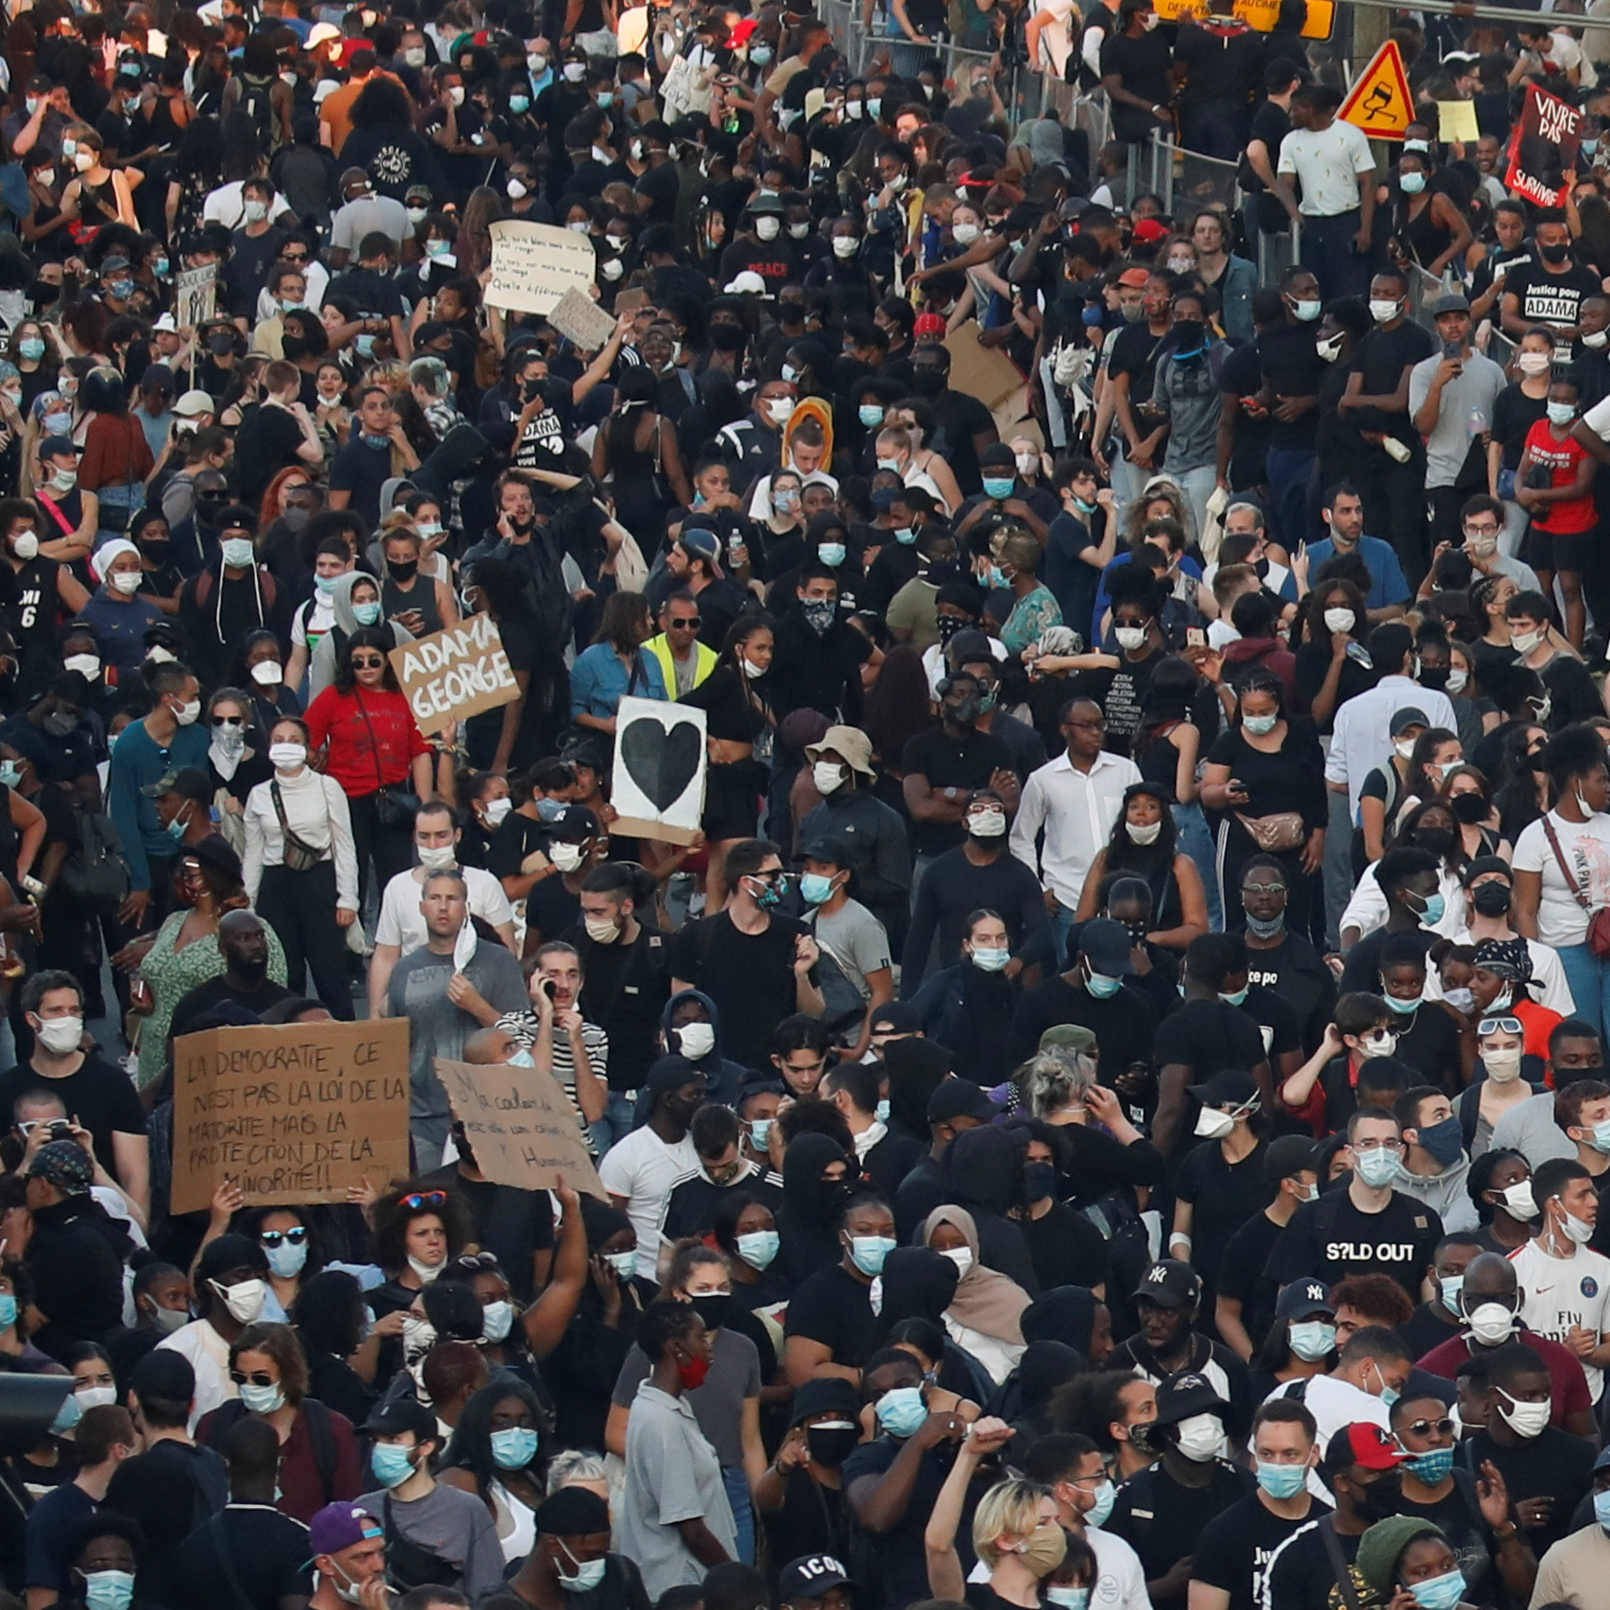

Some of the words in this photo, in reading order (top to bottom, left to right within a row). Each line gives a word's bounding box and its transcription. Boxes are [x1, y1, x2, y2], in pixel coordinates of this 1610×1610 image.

[1535, 90, 1580, 135] VIVRE
[1539, 120, 1562, 145] PAS
[1512, 169, 1565, 207] SURVIVRE
[1526, 283, 1557, 296] Justice
[1558, 286, 1580, 300] pour
[1525, 299, 1578, 319] ADAMA
[526, 413, 562, 438] DAMA
[21, 605, 38, 629] 6
[404, 615, 500, 683] ADAMA
[411, 652, 517, 719] GEORGE
[187, 1057, 207, 1084] LA
[352, 1041, 382, 1067] CE
[243, 1081, 282, 1109] PAS
[289, 1080, 312, 1107] LA
[349, 1079, 378, 1104] DE
[384, 1078, 406, 1101] LA
[327, 1111, 347, 1135] LA
[188, 1138, 304, 1174] PROTECTION
[314, 1140, 344, 1163] DE
[351, 1136, 374, 1162] LA
[1327, 1242, 1374, 1261] S?LD
[1375, 1242, 1415, 1261] OUT
[1148, 1265, 1168, 1284] NY
[1306, 1284, 1324, 1301] NY
